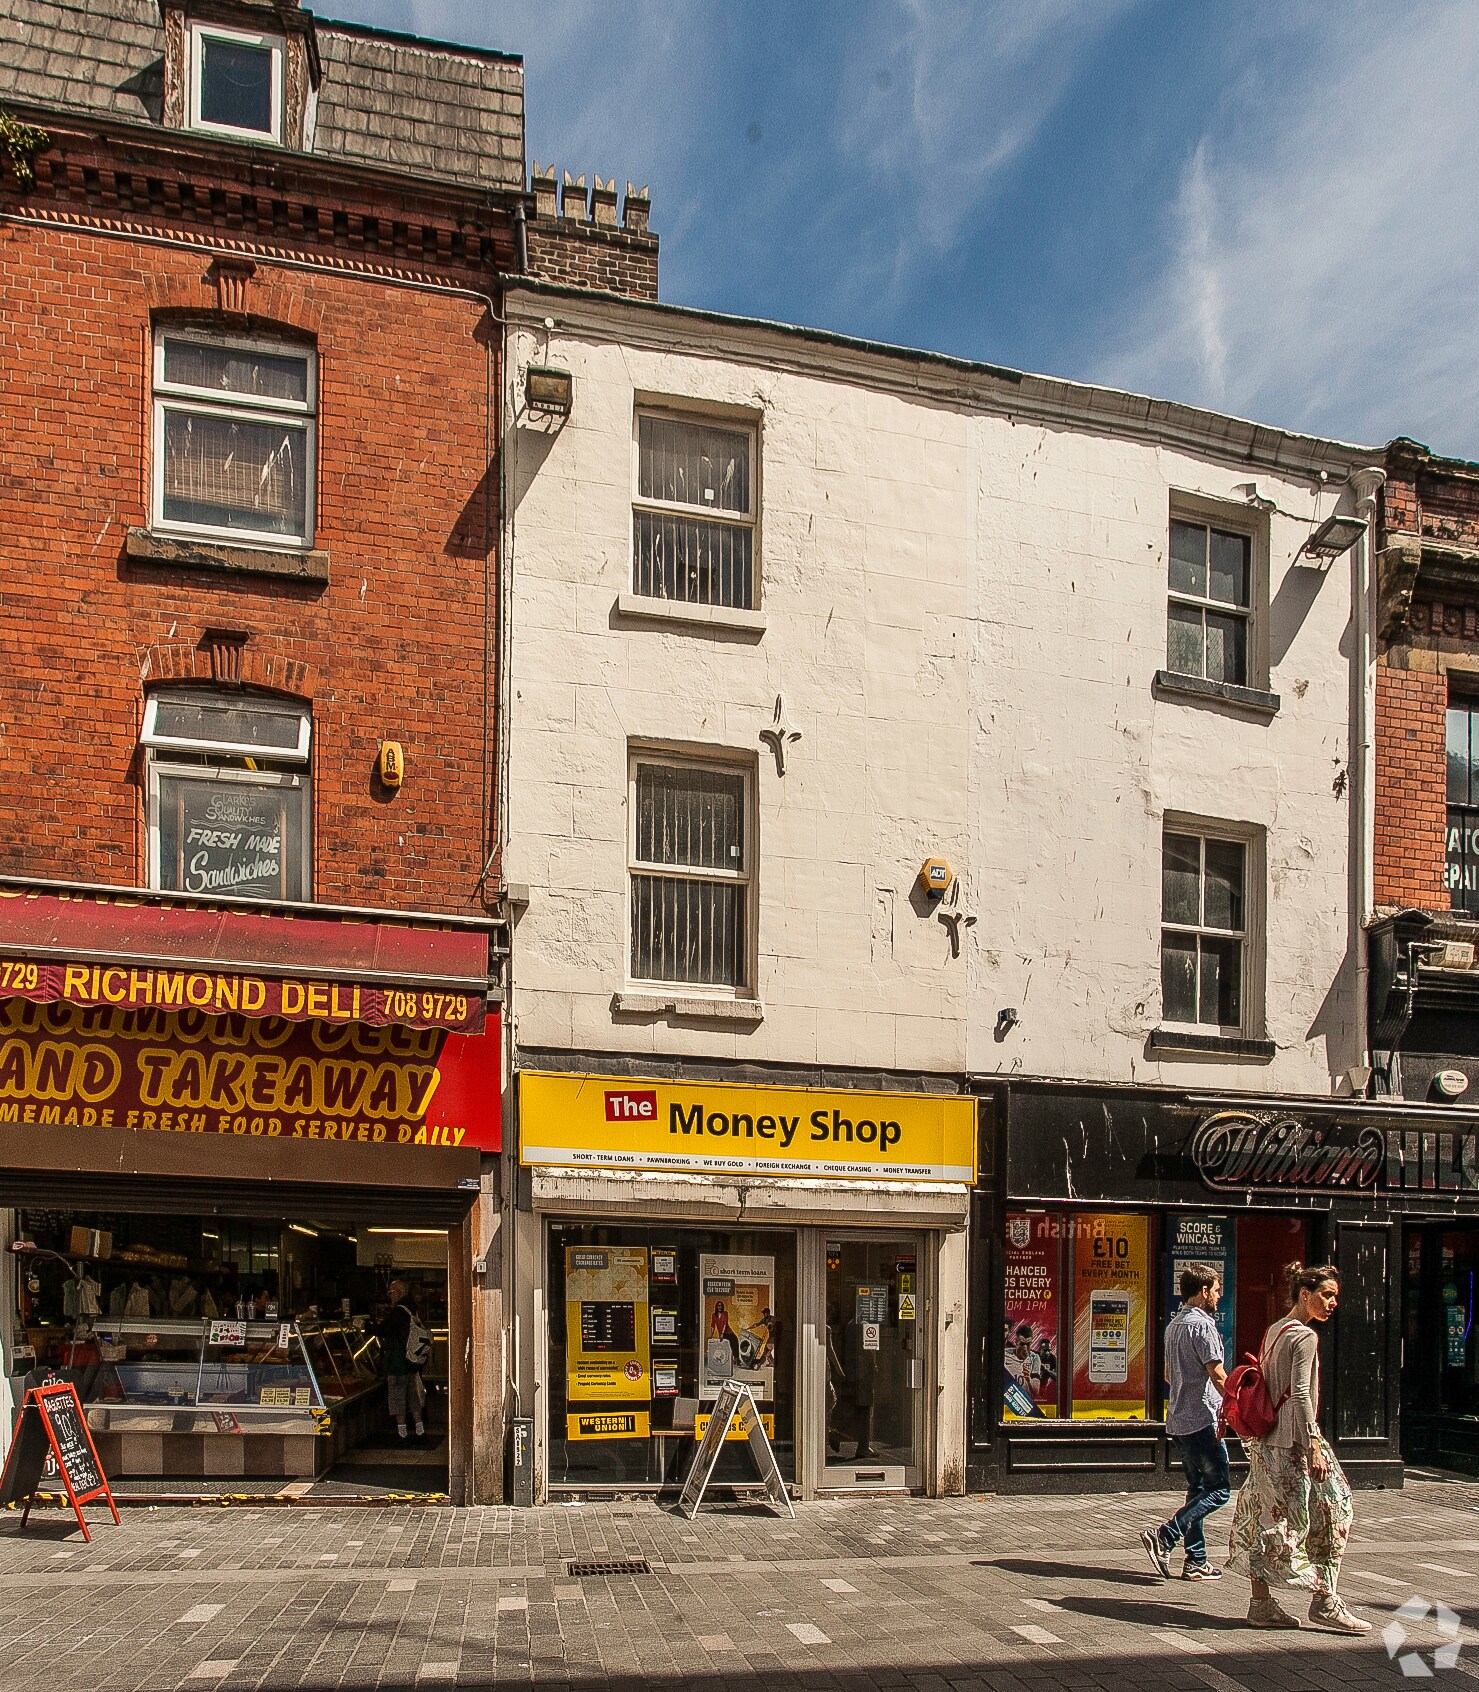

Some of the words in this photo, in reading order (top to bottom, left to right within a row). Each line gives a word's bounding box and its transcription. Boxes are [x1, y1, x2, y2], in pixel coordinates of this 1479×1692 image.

[205, 807, 266, 825] SANDWICHES
[187, 828, 242, 850] FRESH
[245, 834, 280, 854] MADE
[186, 850, 279, 892] Sandwiches
[931, 868, 946, 878] ADT
[63, 964, 266, 1010] RICHMOND
[281, 979, 361, 1018] DELI
[383, 989, 417, 1017] 708
[422, 991, 468, 1020] 9729
[0, 1038, 123, 1102] AND
[136, 1048, 442, 1118] TAKEAWAY
[126, 1110, 206, 1133] FRESH
[218, 1115, 282, 1136] FOOD
[292, 1120, 387, 1142] SERVED
[398, 1124, 466, 1146] DAILY
[609, 1094, 653, 1117] The
[669, 1103, 800, 1147] Money
[810, 1112, 902, 1151] Shop
[1192, 1111, 1386, 1190] William
[646, 1157, 691, 1165] PAWNBROKING
[1180, 1223, 1213, 1233] SCORE
[1215, 1225, 1221, 1233] &
[1176, 1233, 1223, 1244] WINCAST
[1093, 1237, 1129, 1258] £10
[1091, 1260, 1113, 1269] FREE
[1114, 1260, 1131, 1270] BET
[1081, 1269, 1110, 1278] EVERY
[1110, 1270, 1140, 1279] MONTH
[1019, 1277, 1052, 1288] EVERY
[1025, 1300, 1047, 1311] 1PM
[580, 1416, 625, 1426] WESTERN
[594, 1423, 625, 1432] UNION
